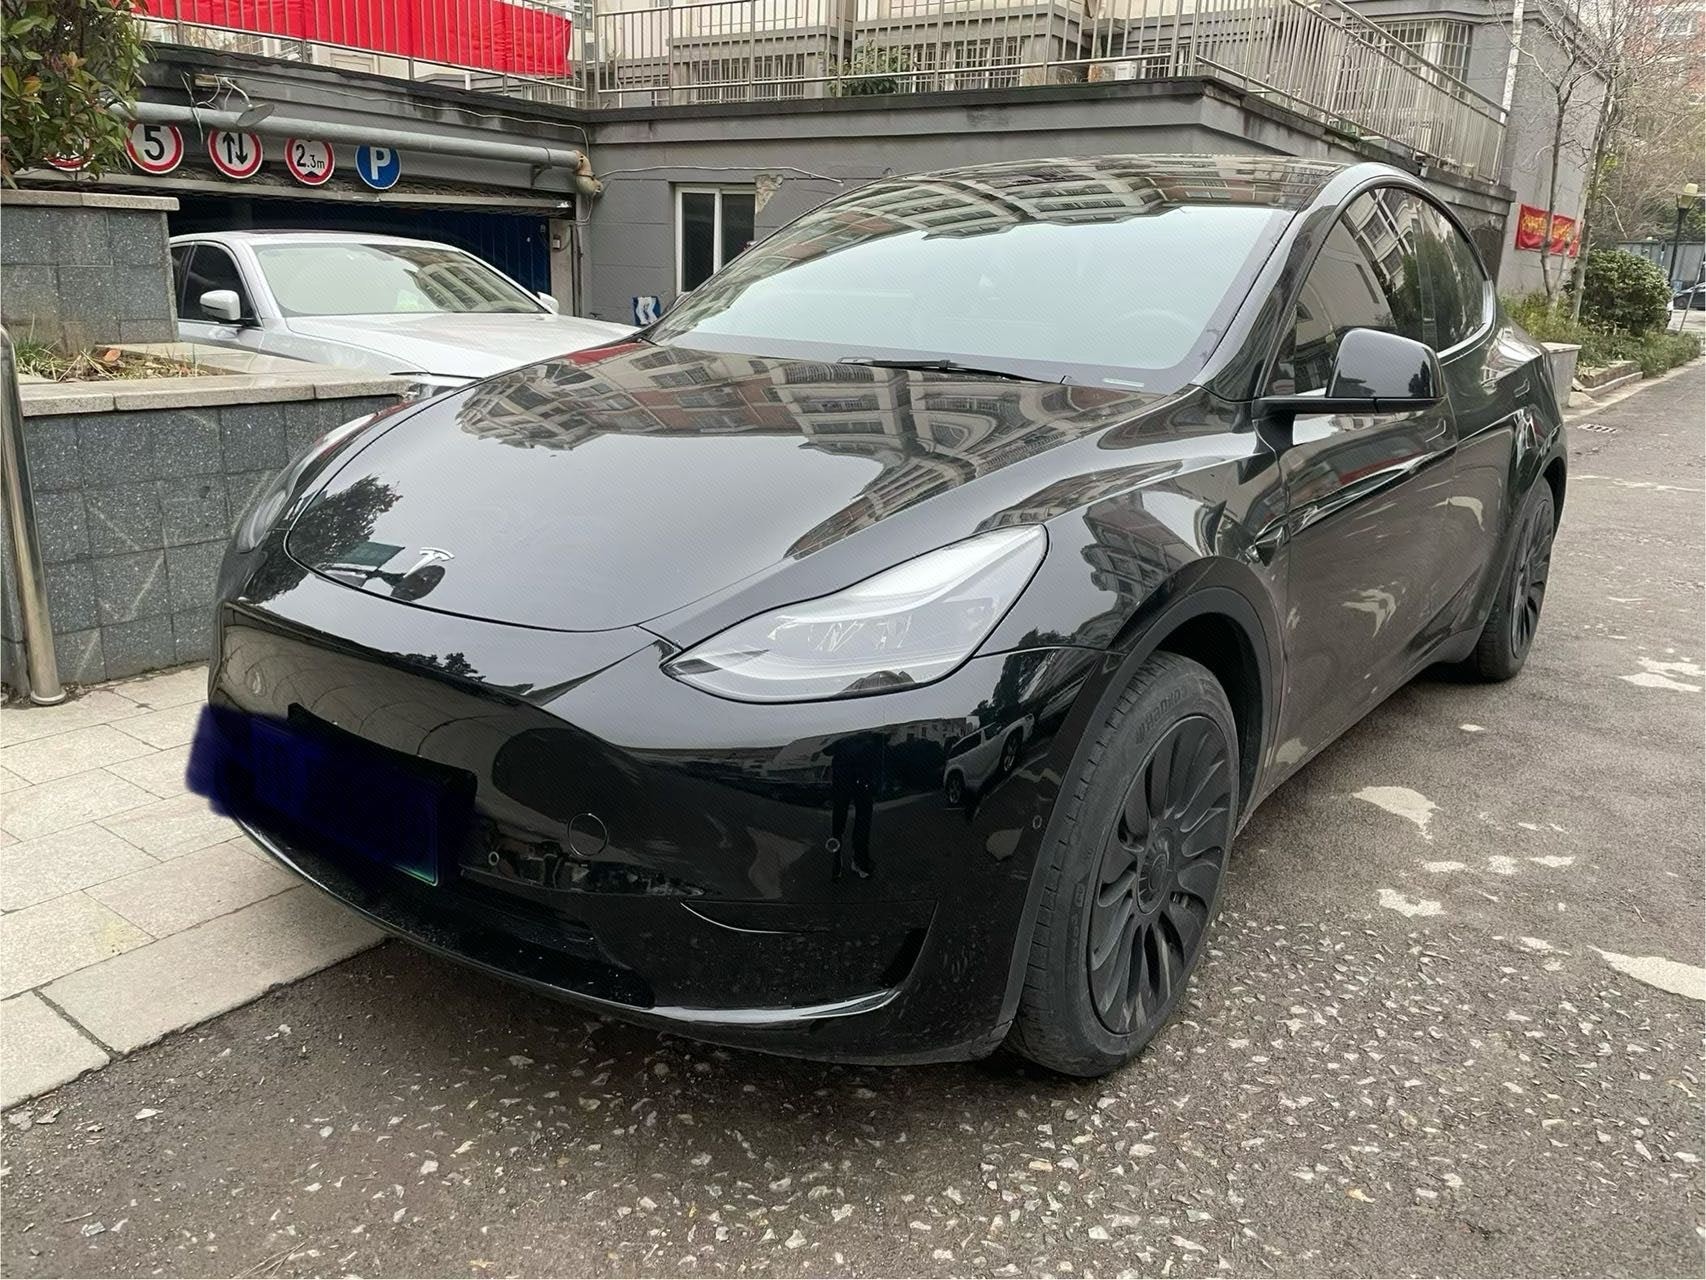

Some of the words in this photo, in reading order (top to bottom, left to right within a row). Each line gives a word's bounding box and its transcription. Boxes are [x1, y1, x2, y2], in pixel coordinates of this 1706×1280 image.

[144, 126, 165, 161] 5
[296, 143, 325, 169] 2.3m
[370, 147, 391, 180] P
